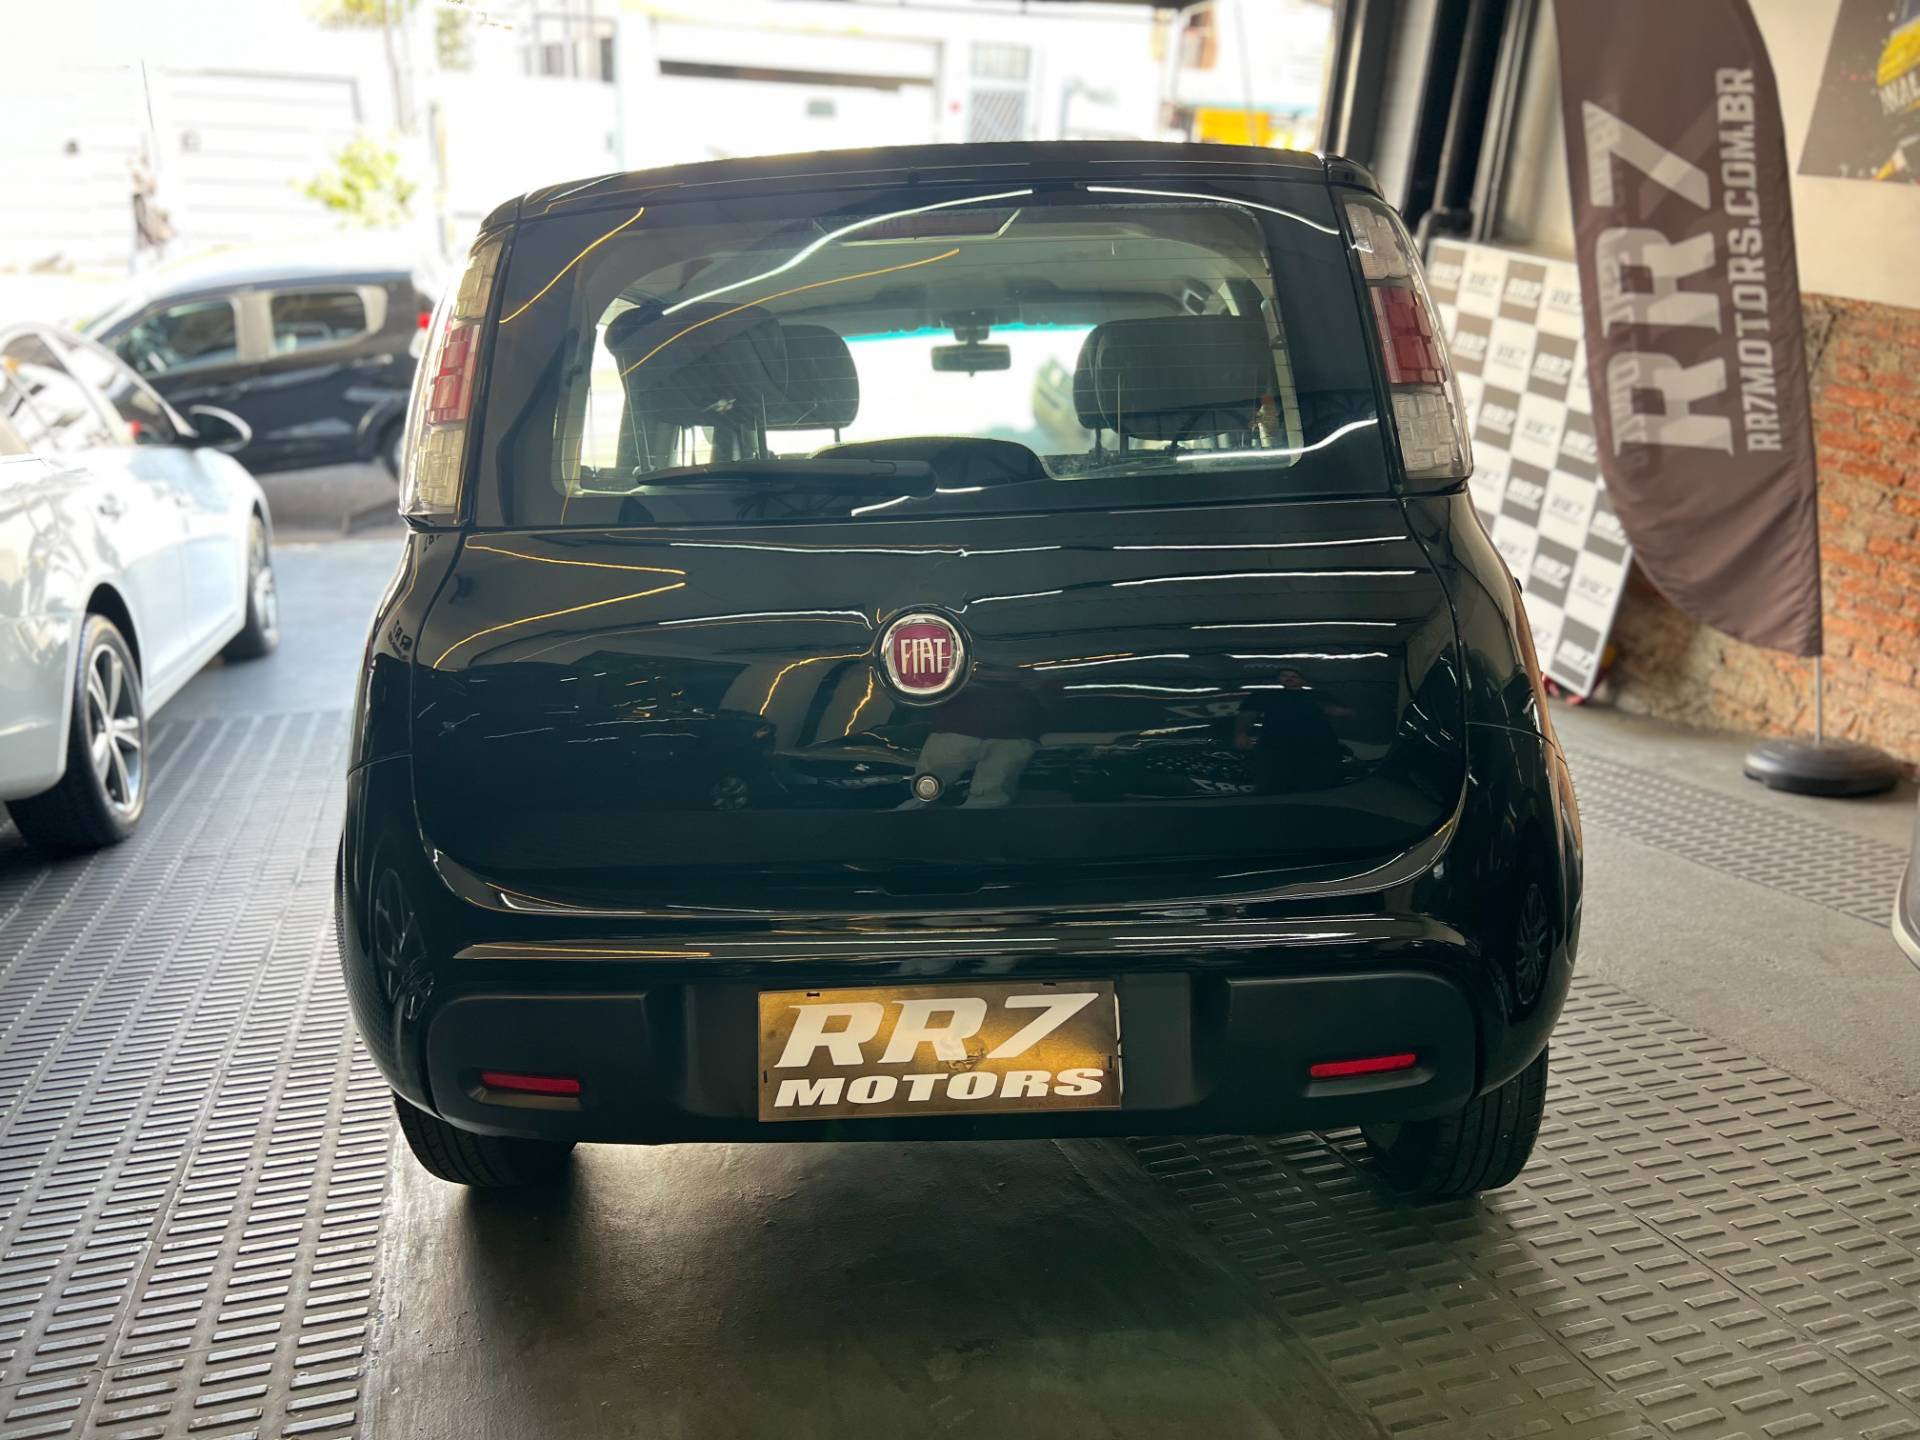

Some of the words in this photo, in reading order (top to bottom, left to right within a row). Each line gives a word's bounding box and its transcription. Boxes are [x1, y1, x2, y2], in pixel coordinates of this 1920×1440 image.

[1582, 100, 1734, 457] RR7
[901, 638, 946, 674] FIAT
[774, 992, 1099, 1068] RR7
[774, 1068, 1104, 1107] MOTORS
